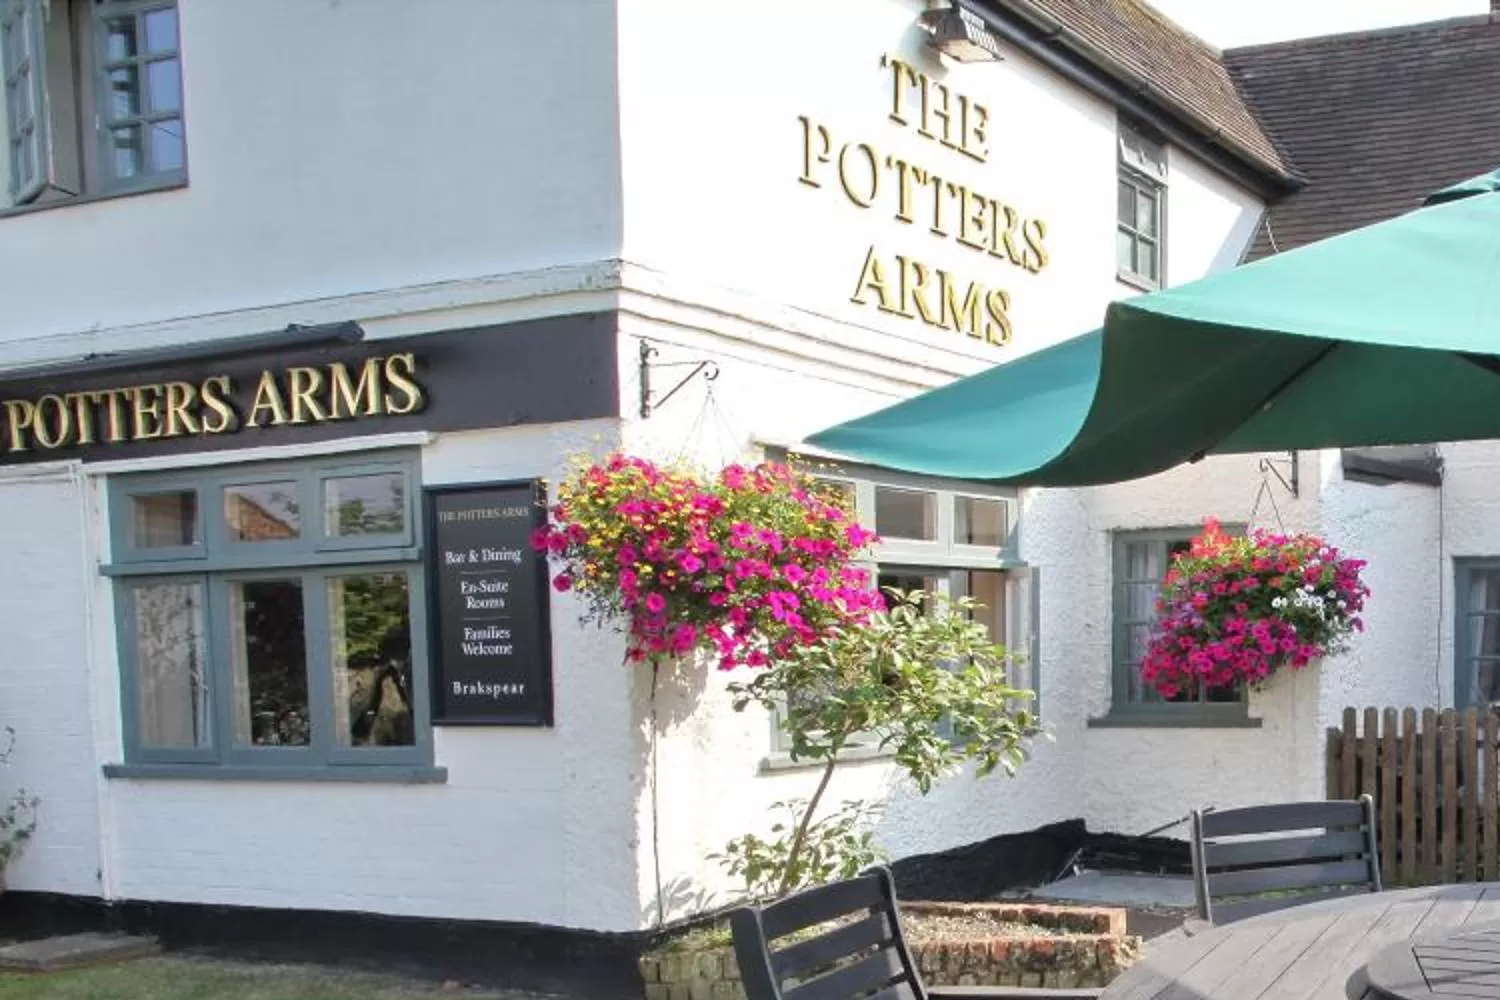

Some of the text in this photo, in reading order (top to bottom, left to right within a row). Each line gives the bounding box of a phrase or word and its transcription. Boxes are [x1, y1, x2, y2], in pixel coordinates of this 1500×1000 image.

[880, 52, 991, 163] THE
[798, 115, 1050, 274] POTTERS
[850, 244, 1012, 346] ARMS
[4, 352, 425, 452] POTTERS ARMS
[445, 547, 523, 565] Bar & Dining
[460, 579, 509, 595] En-Suite
[466, 595, 505, 609] Rooms
[463, 625, 511, 641] Families
[461, 641, 513, 656] Welcome
[452, 681, 525, 699] Brakspear
